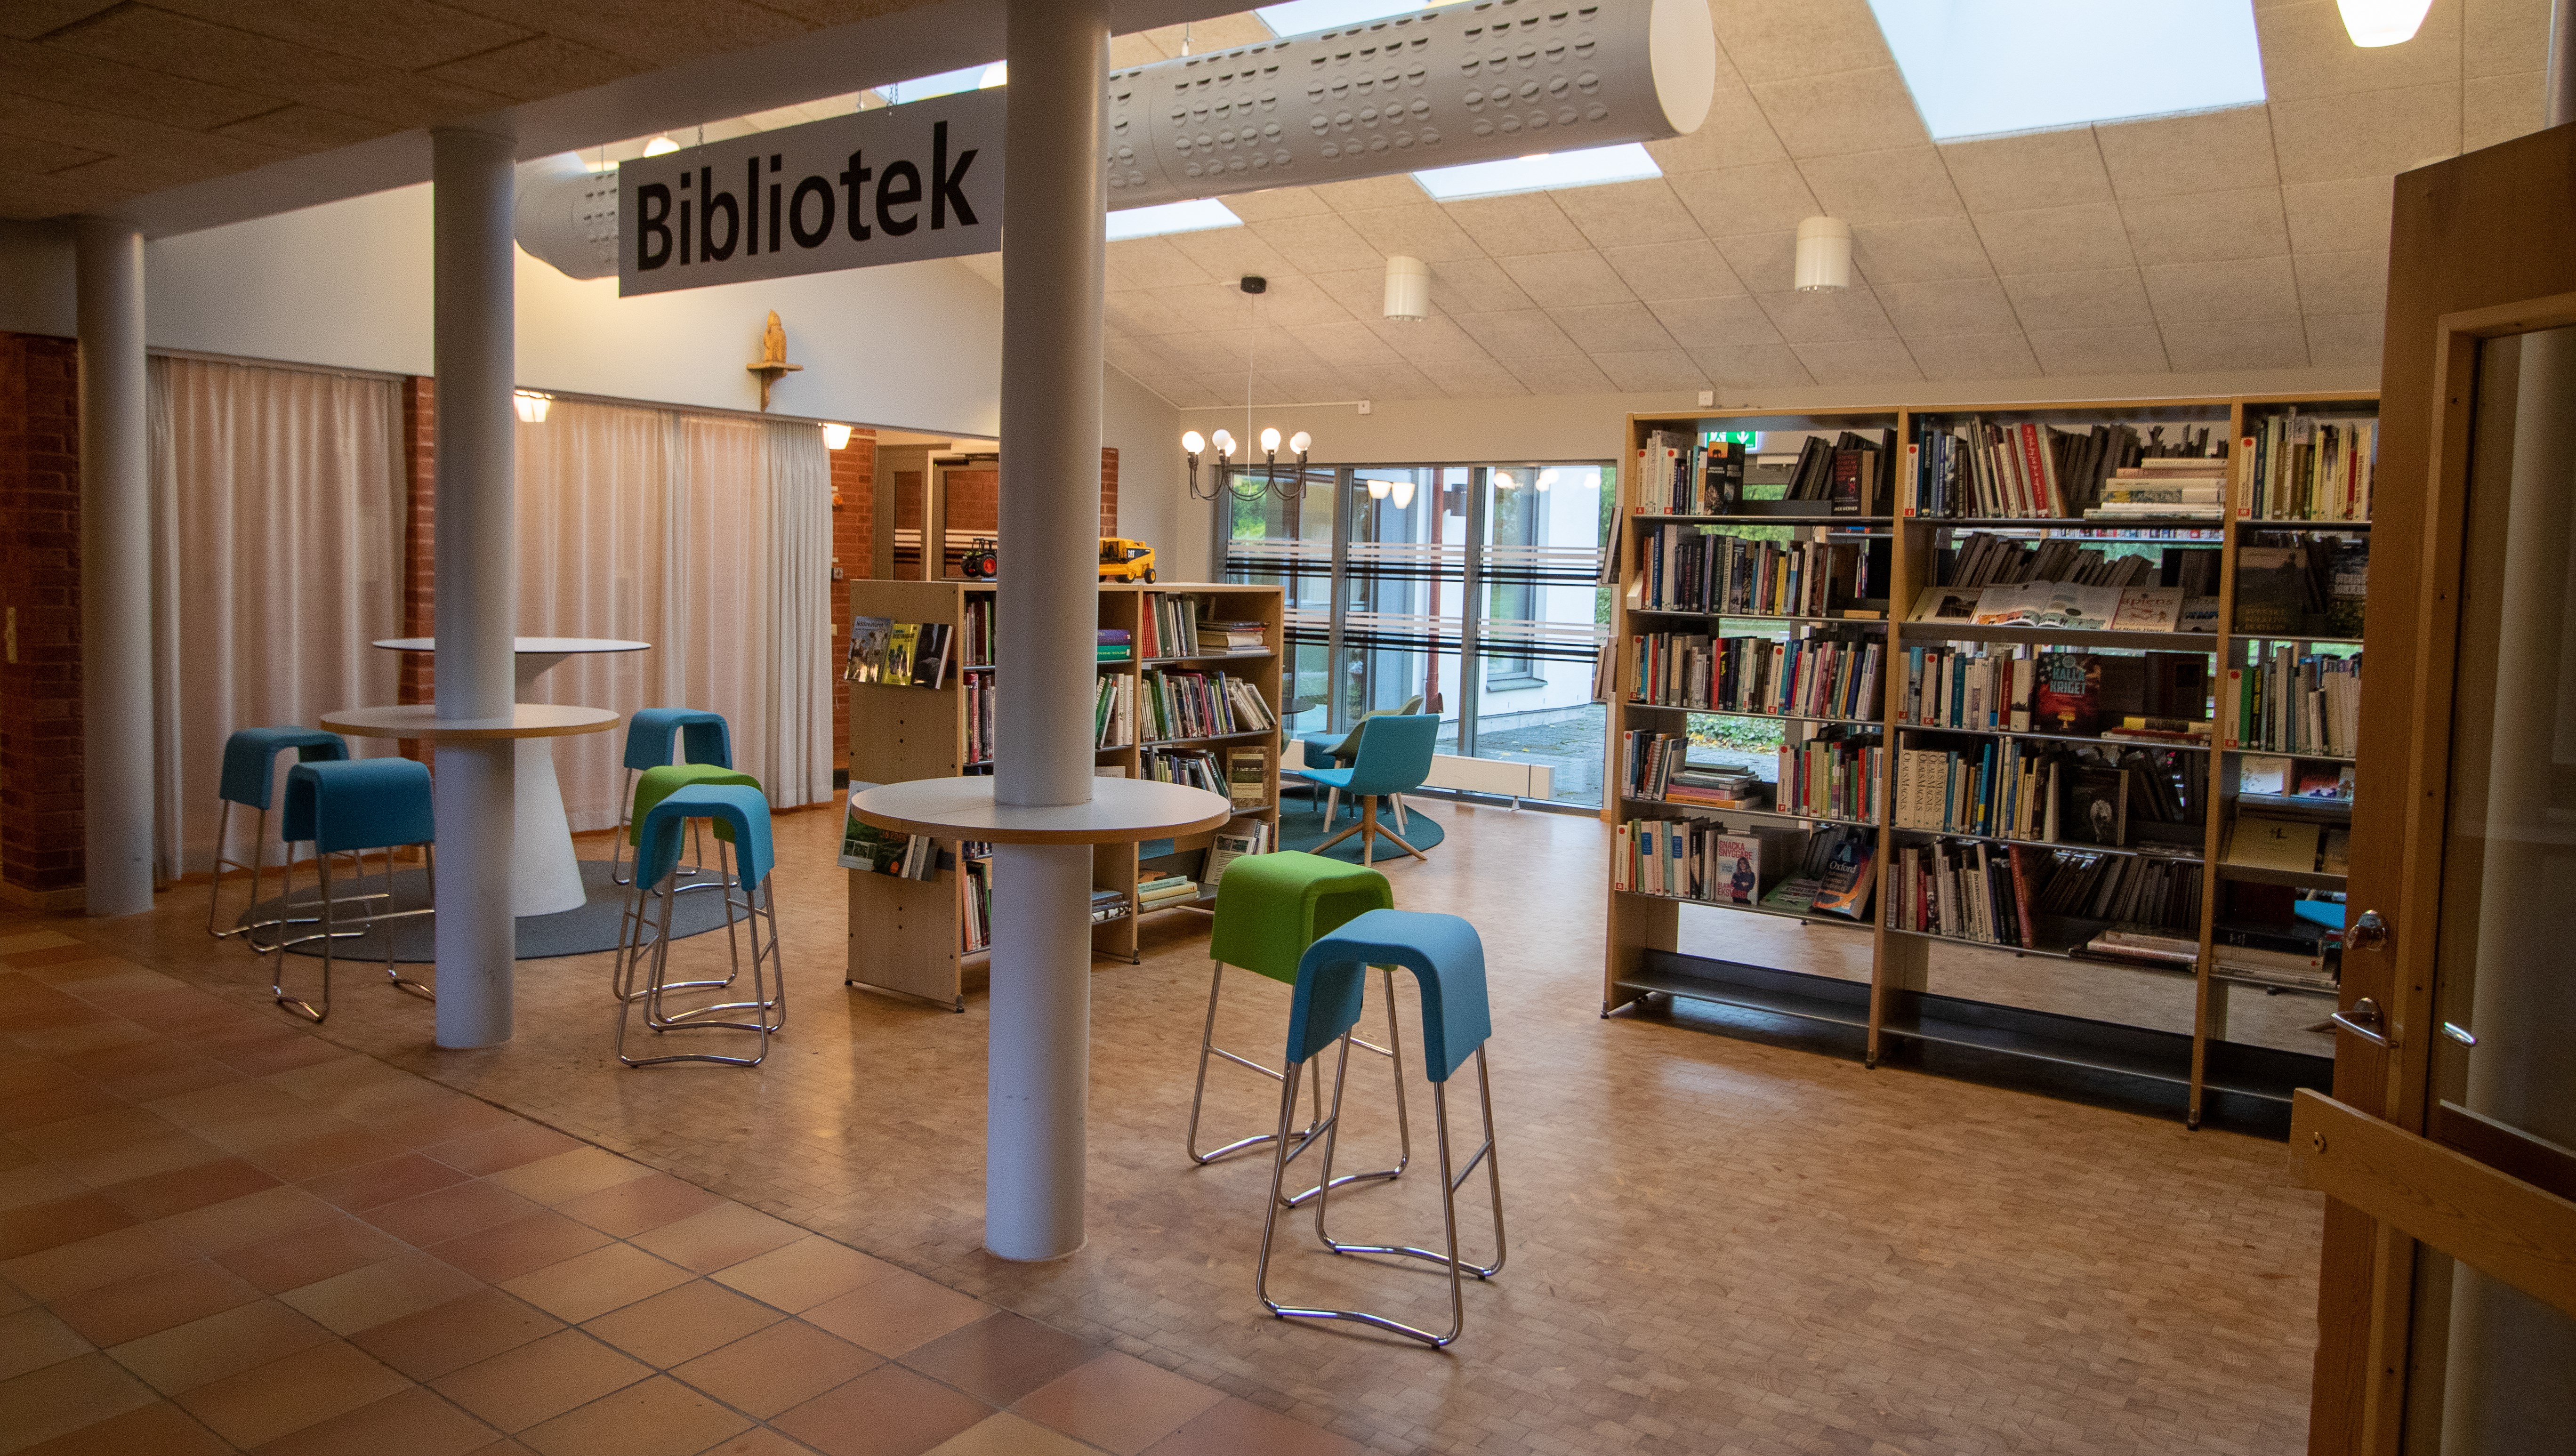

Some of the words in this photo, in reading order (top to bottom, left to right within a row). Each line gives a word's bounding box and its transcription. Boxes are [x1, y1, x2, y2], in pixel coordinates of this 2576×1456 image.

[637, 121, 979, 272] Bibliotek
[2053, 668, 2085, 681] KALLA
[2050, 681, 2086, 695] KRIGET
[1719, 840, 1745, 851] SNACKA
[1718, 849, 1753, 860] SNYGGARE
[1830, 861, 1858, 874] Oxford
